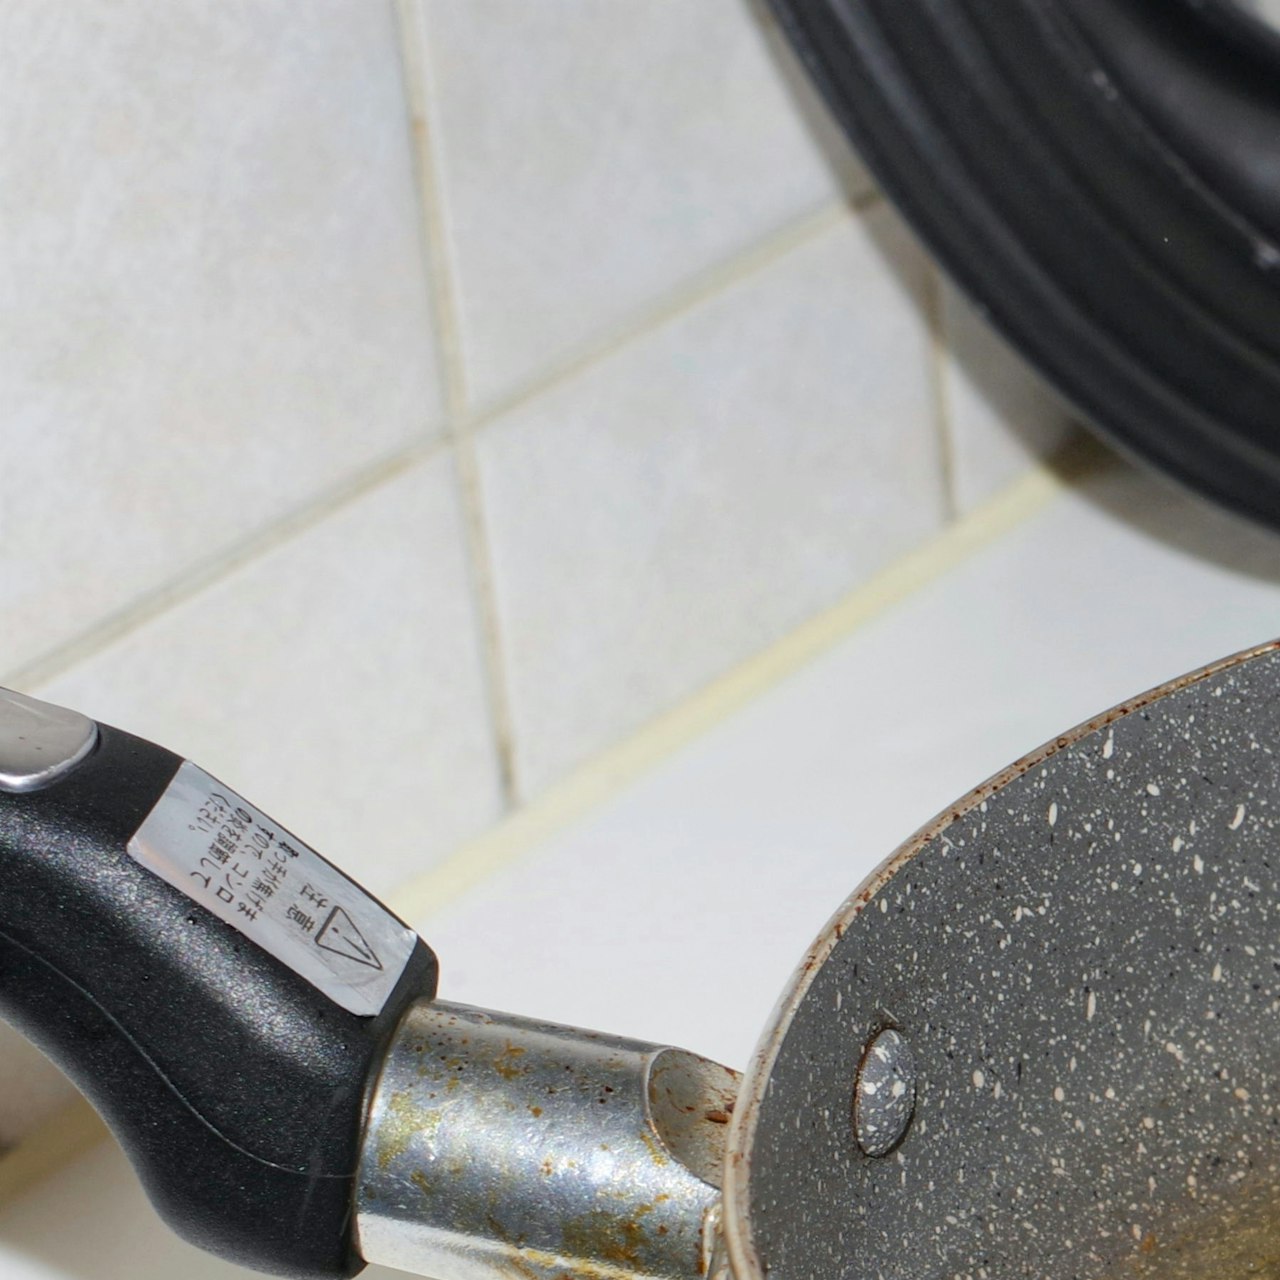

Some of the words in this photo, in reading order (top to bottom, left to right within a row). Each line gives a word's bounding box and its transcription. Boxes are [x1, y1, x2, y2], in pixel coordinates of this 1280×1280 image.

[189, 793, 231, 832] ください。
[190, 807, 253, 888] の炎を調節して
[216, 824, 276, 903] すので、コンロ
[237, 841, 299, 921] 取っ手が焦げま
[286, 883, 328, 932] 注意
